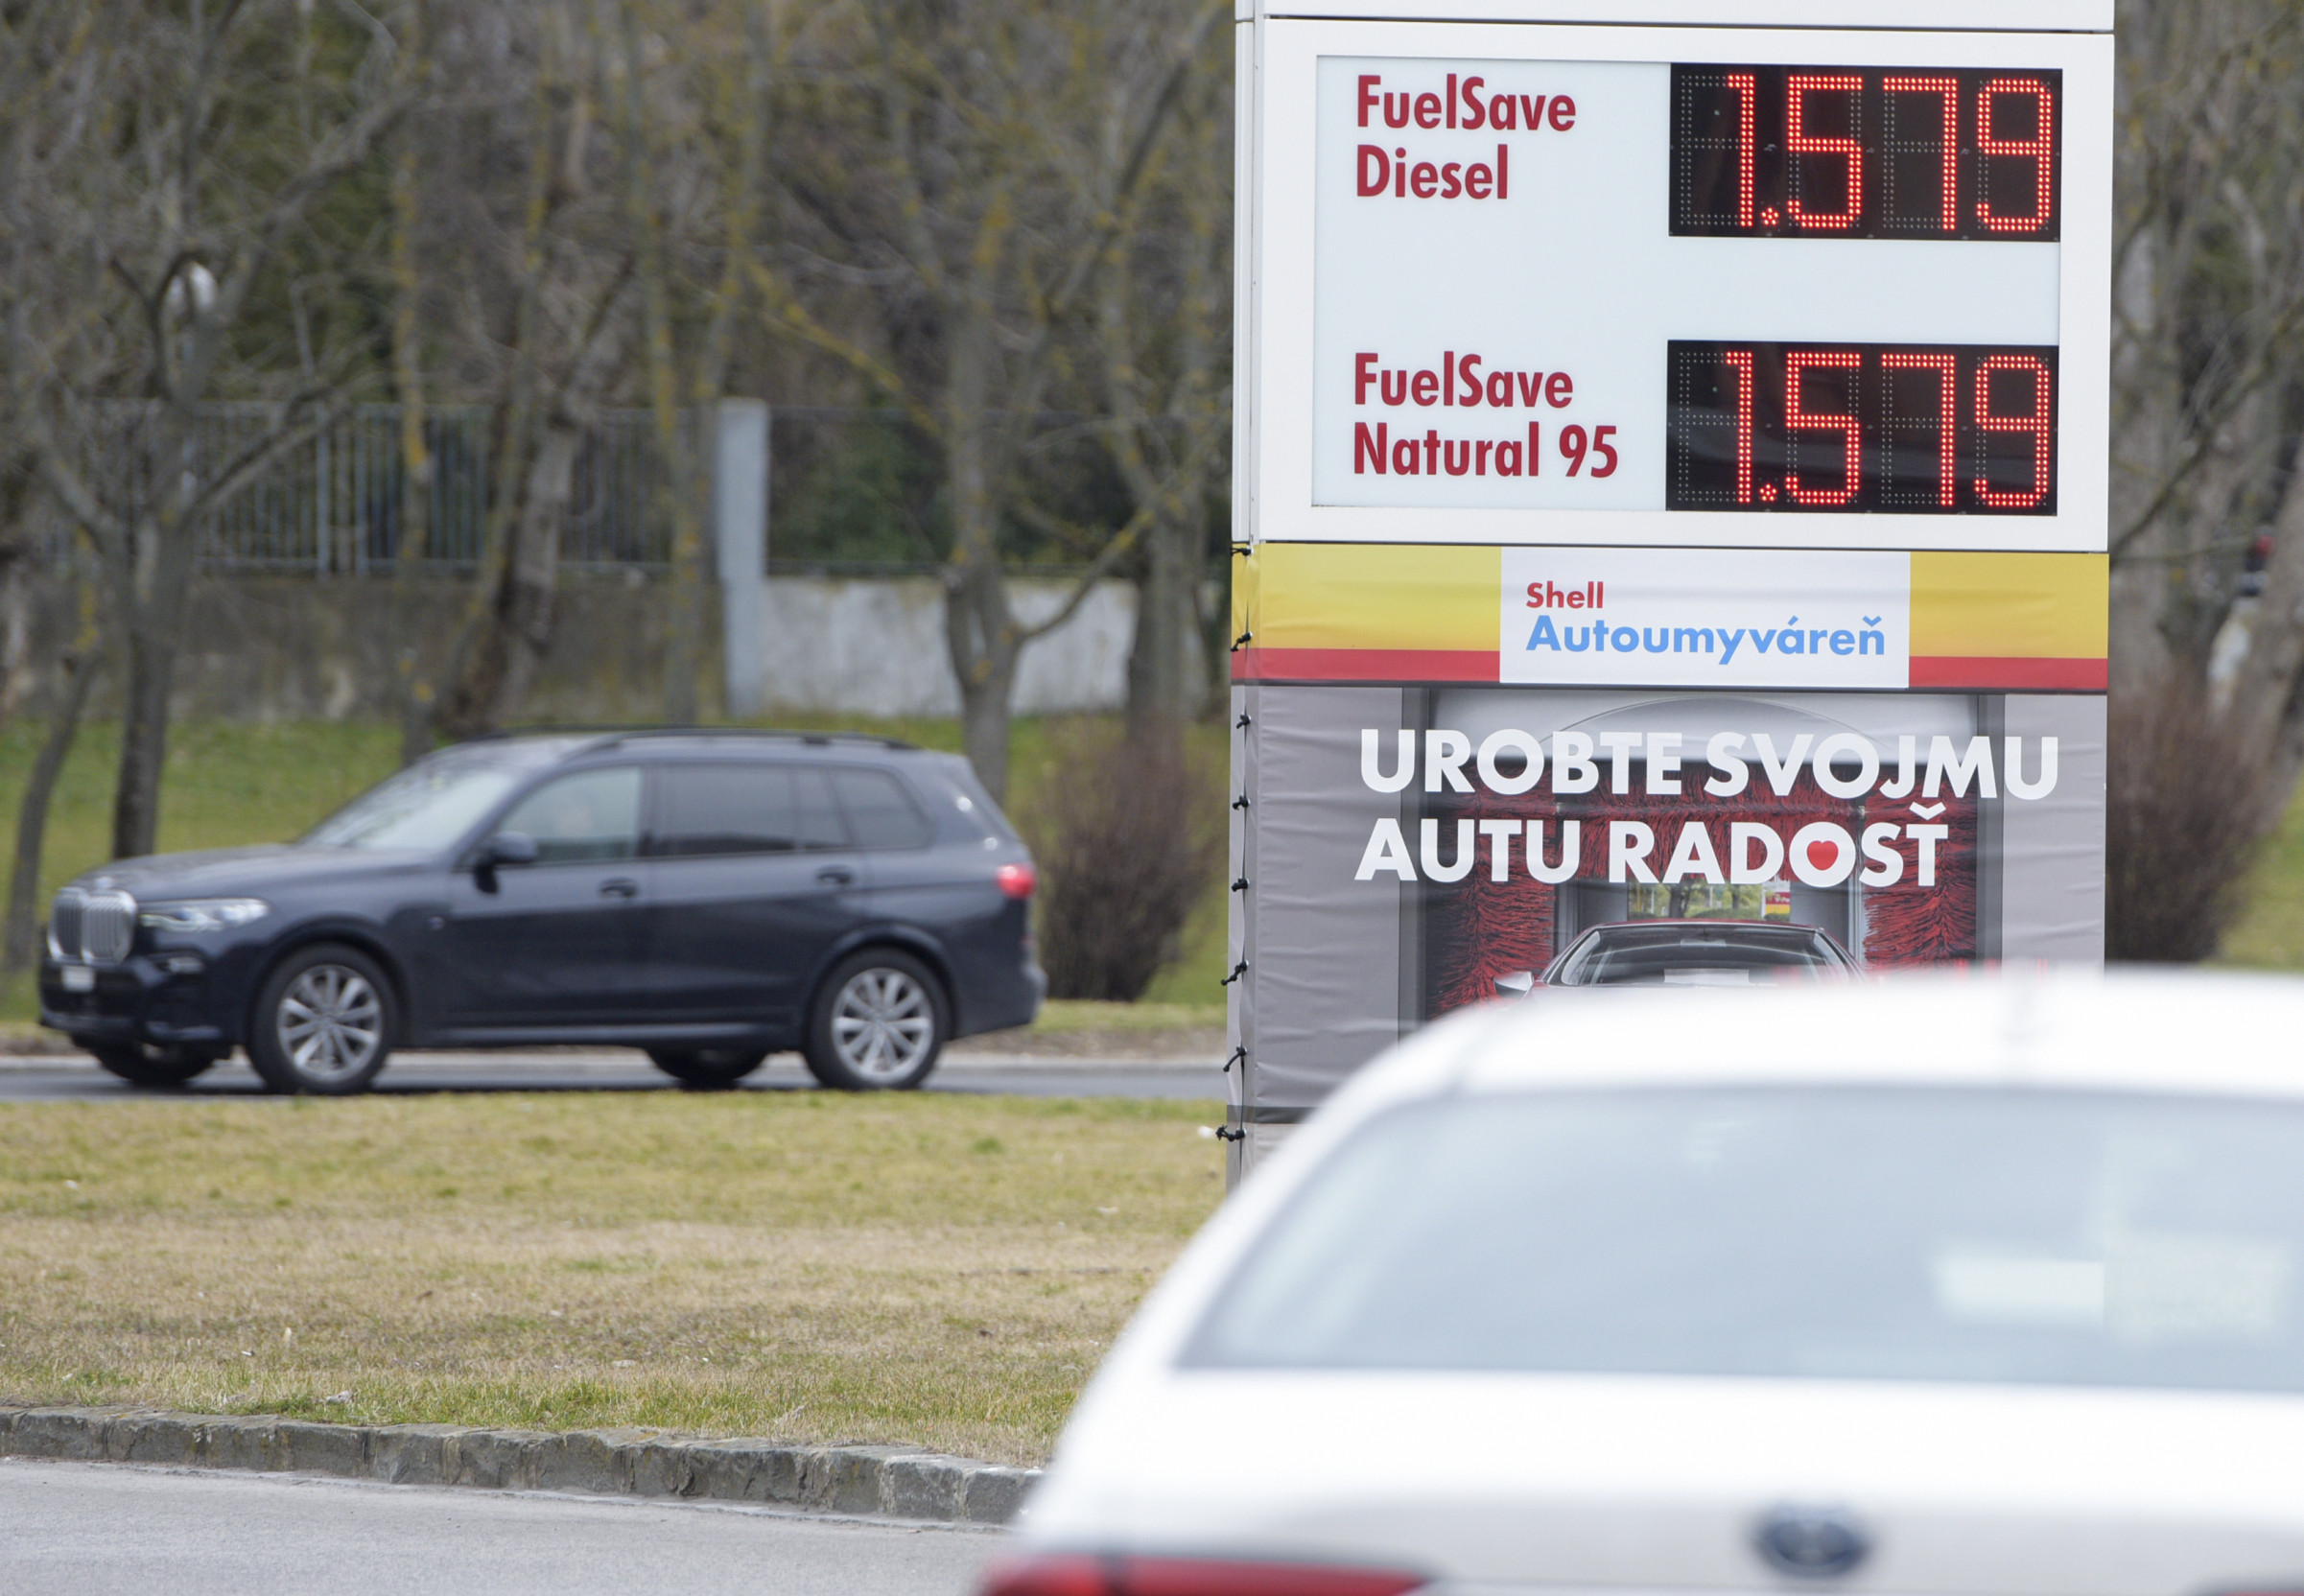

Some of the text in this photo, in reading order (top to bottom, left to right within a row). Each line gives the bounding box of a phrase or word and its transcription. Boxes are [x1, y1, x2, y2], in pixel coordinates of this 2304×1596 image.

[1356, 74, 1576, 131] FuelSave
[1356, 144, 1509, 200] Diesel
[1727, 74, 2053, 232] 1.579
[1354, 351, 1574, 409] FuelSave
[1353, 421, 1619, 478] Natural 95
[1725, 351, 2051, 507] 1.579
[1526, 580, 1605, 610] Shell
[1526, 614, 1886, 666] Autoumyváreň
[1360, 727, 2059, 801] UROBTE SVOJMU
[1354, 802, 1949, 888] AUTU RADOSŤ
